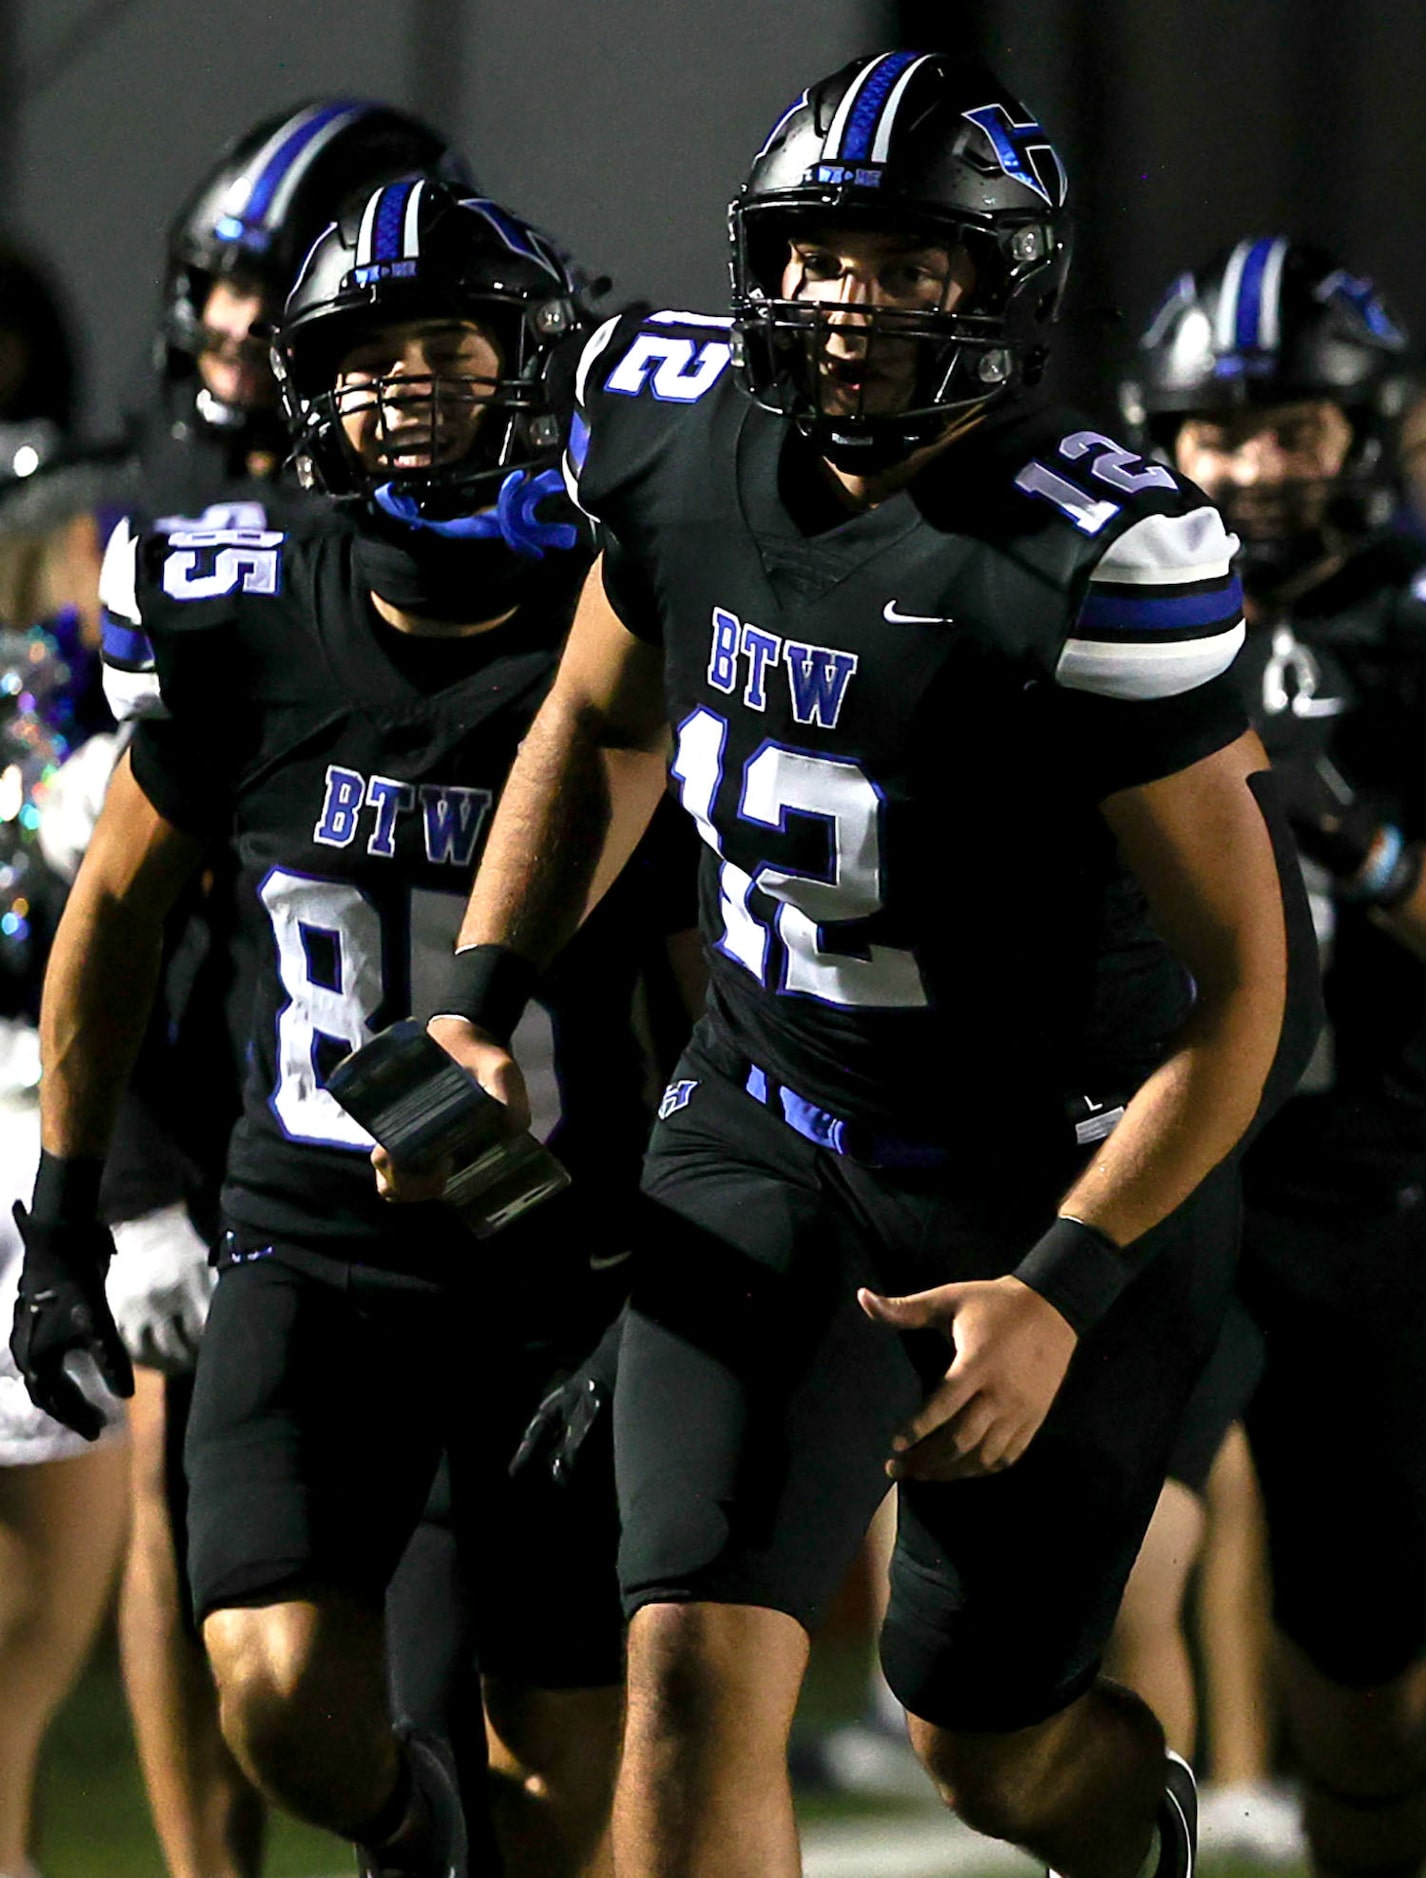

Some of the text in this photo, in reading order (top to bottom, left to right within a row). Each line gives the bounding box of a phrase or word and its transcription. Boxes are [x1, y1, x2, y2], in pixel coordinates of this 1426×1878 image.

[1012, 428, 1180, 539] 12
[707, 606, 858, 730] BTW
[313, 764, 493, 868] BTW
[670, 702, 932, 1012] 12
